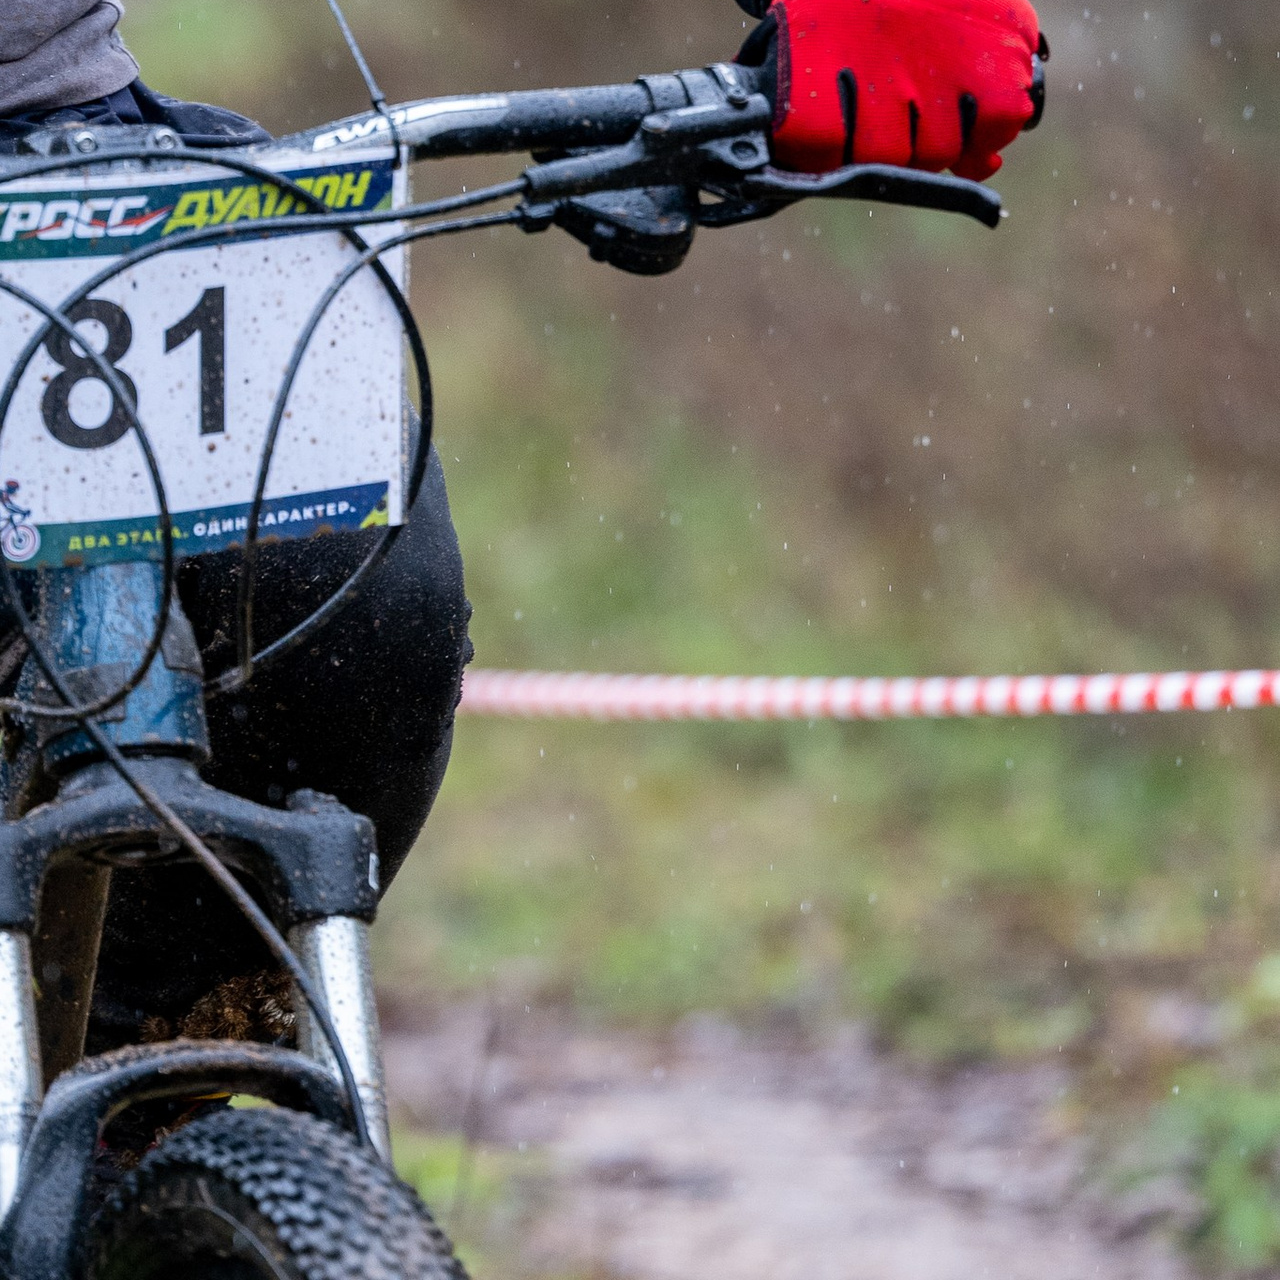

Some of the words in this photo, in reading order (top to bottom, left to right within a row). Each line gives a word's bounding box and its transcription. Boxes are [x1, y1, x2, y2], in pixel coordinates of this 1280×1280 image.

[41, 285, 226, 450] 81
[68, 534, 111, 551] ДВА
[193, 518, 248, 538] ОДИН
[255, 500, 358, 529] АРАКТЕР.
